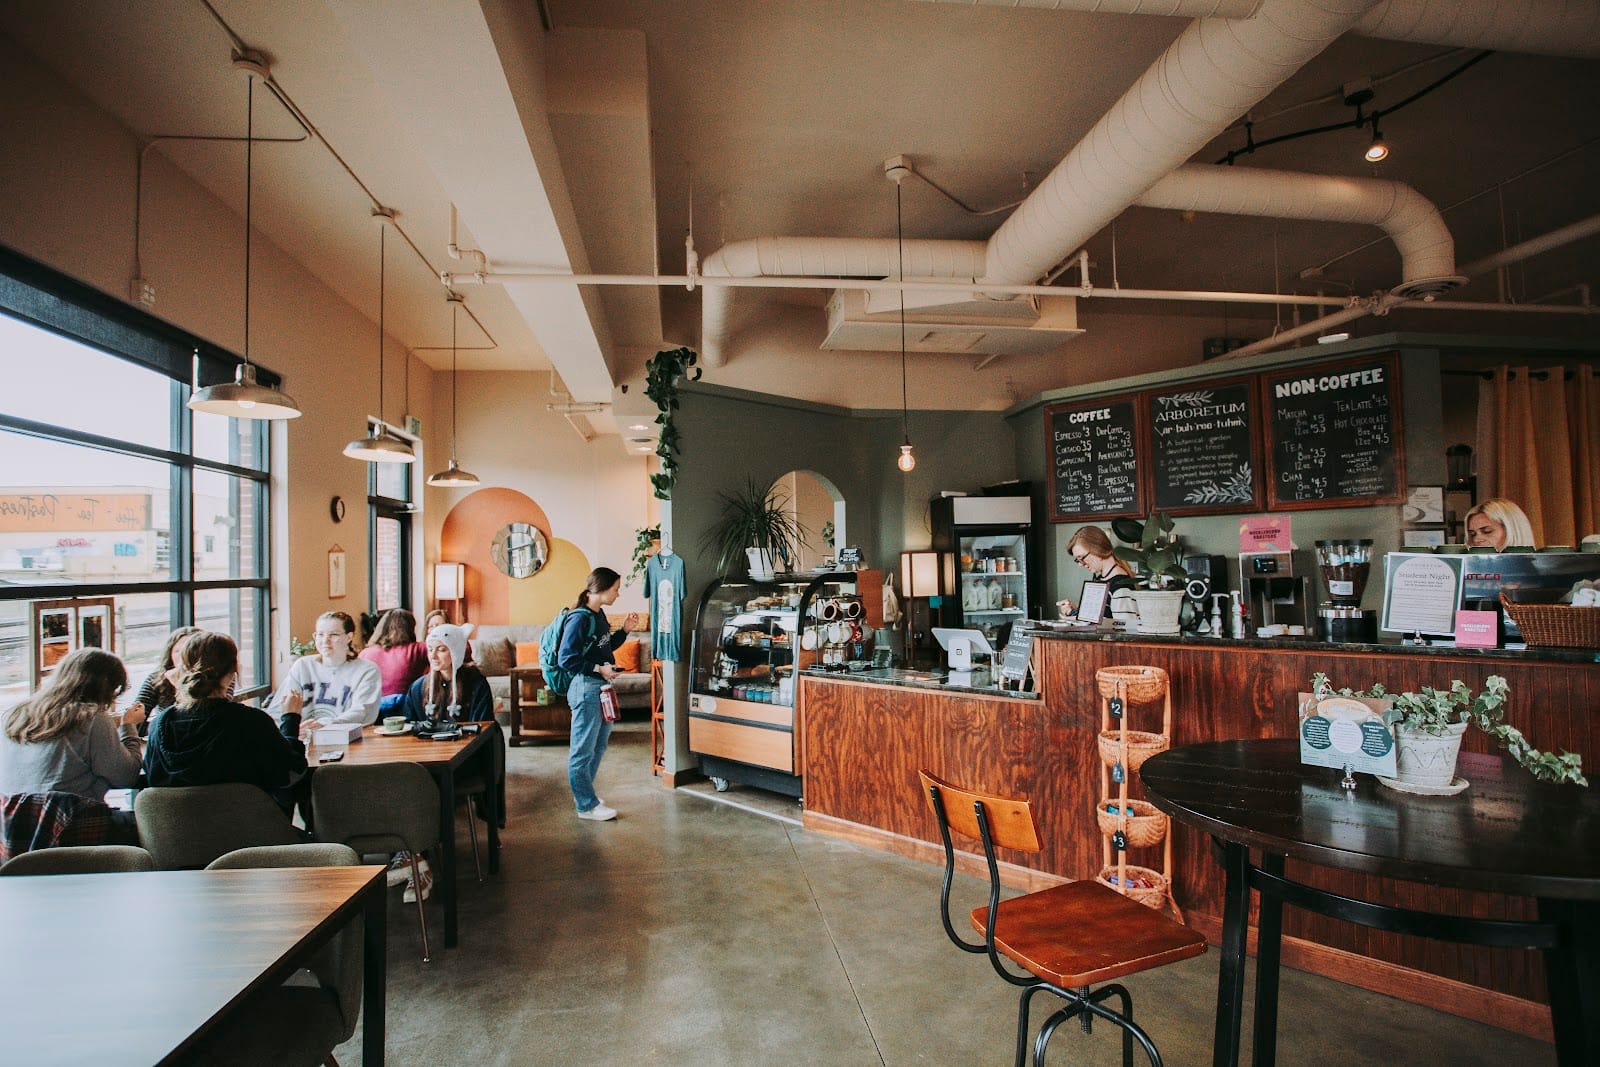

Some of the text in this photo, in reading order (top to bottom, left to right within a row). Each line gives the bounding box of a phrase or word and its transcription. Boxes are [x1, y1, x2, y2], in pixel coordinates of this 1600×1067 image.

[1333, 400, 1350, 412] TEA
[1350, 399, 1373, 411] LATTE
[1069, 408, 1111, 424] COFFEE
[1156, 402, 1245, 423] ARBORETUM
[1277, 408, 1307, 420] MATCHA
[1334, 418, 1348, 430] HOT
[1054, 431, 1082, 441] ESPRESSO
[1281, 440, 1304, 453] TEA
[1097, 475, 1129, 487] ESPRESSO
[1281, 472, 1303, 483] CHAI
[1107, 485, 1127, 495] TONIC
[1061, 495, 1081, 503] SYRUPS
[1111, 702, 1121, 715] $2
[1113, 834, 1125, 848] $3
